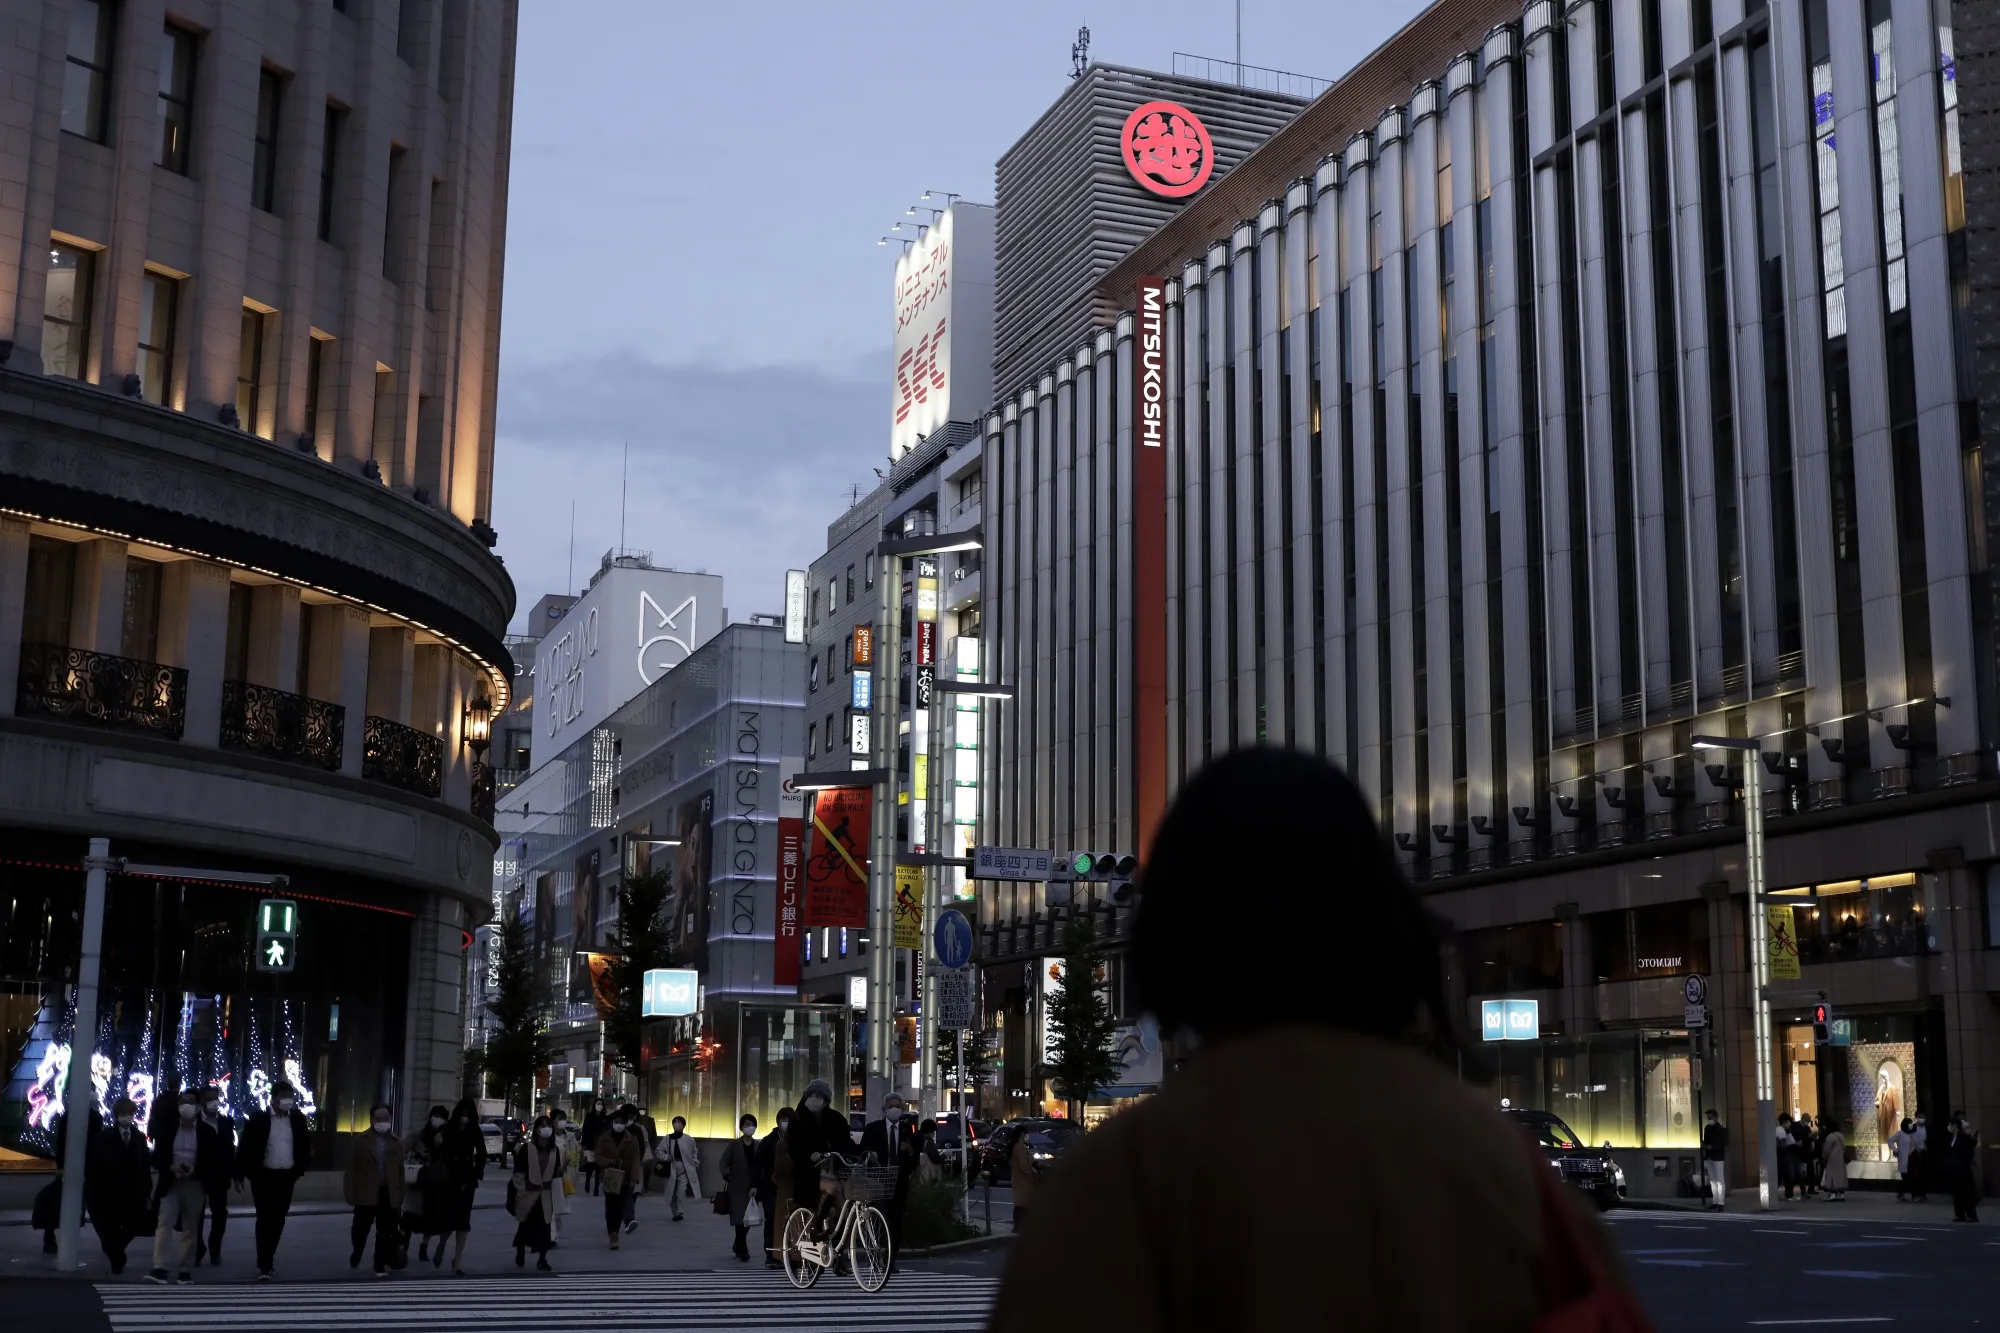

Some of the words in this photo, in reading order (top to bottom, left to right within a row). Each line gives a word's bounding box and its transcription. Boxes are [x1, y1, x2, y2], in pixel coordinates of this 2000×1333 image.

[897, 240, 949, 305] リニューアル
[897, 269, 948, 334] メンテナンス
[896, 317, 946, 424] SEC
[1142, 286, 1162, 448] MITSUKOSHI
[781, 794, 803, 803] MUFG
[821, 804, 831, 812] ON
[831, 802, 865, 813] SIDEWALK
[823, 793, 833, 802] NO
[979, 854, 1048, 871] 銀座四丁目
[999, 868, 1019, 877] Ginza
[781, 835, 799, 937] 三菱UFJ銀行
